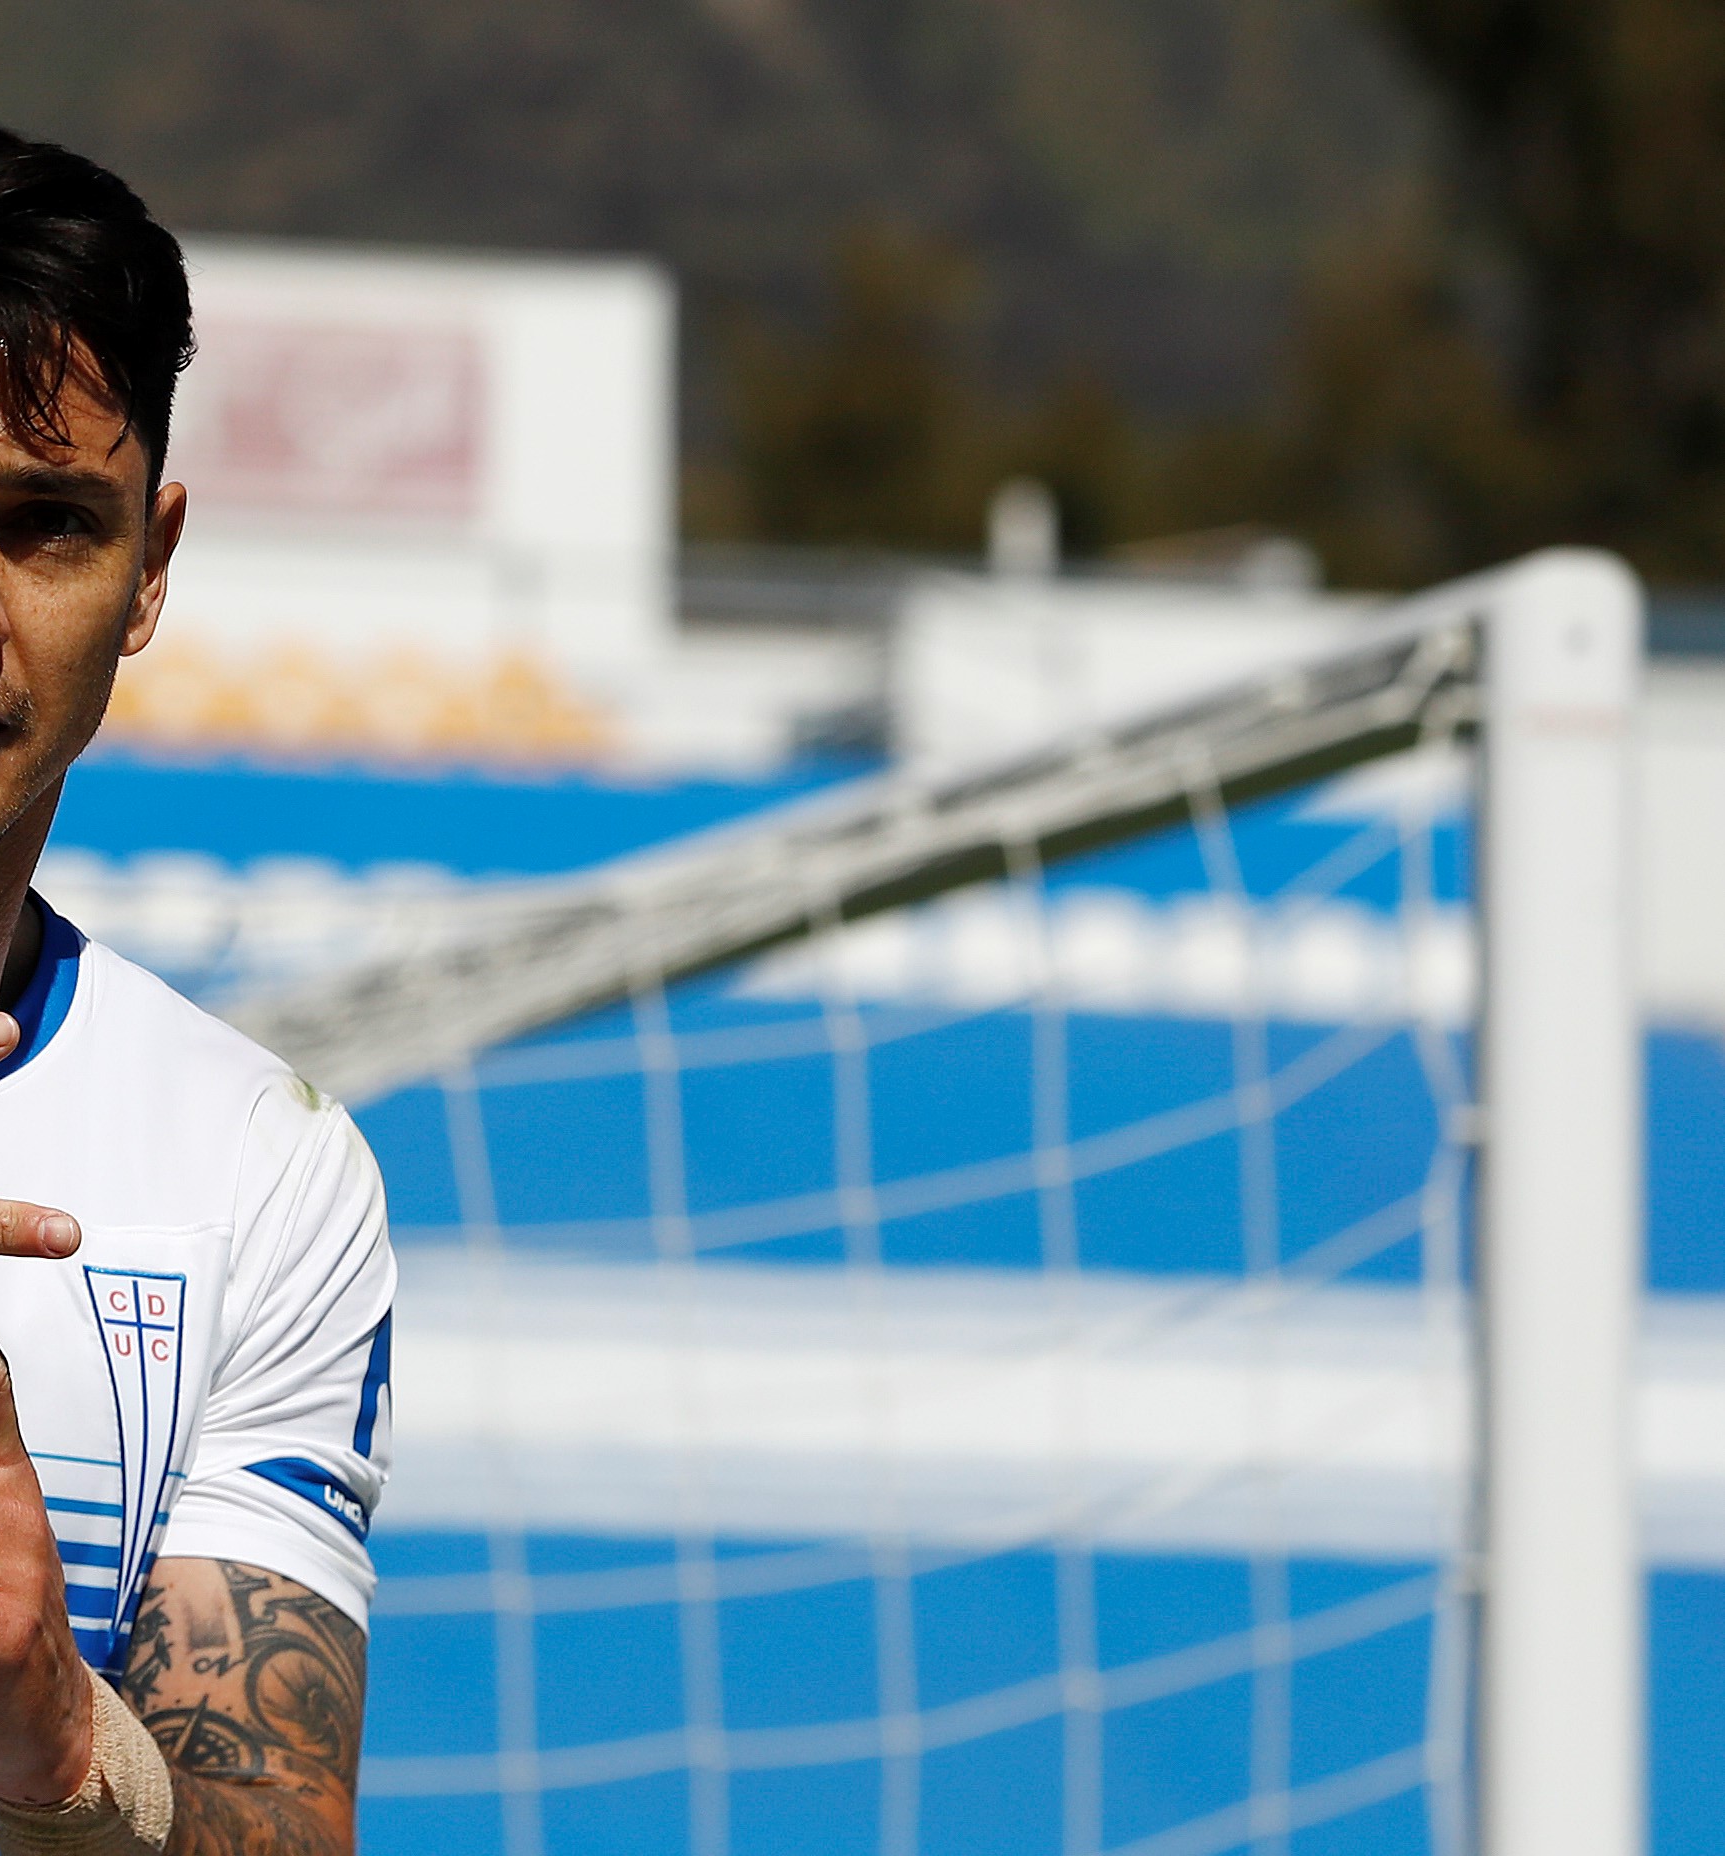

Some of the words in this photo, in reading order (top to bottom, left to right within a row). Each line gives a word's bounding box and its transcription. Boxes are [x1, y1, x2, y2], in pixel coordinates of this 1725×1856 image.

[109, 1290, 128, 1312] C
[147, 1294, 166, 1316] D
[114, 1333, 132, 1356] U
[151, 1338, 169, 1362] C
